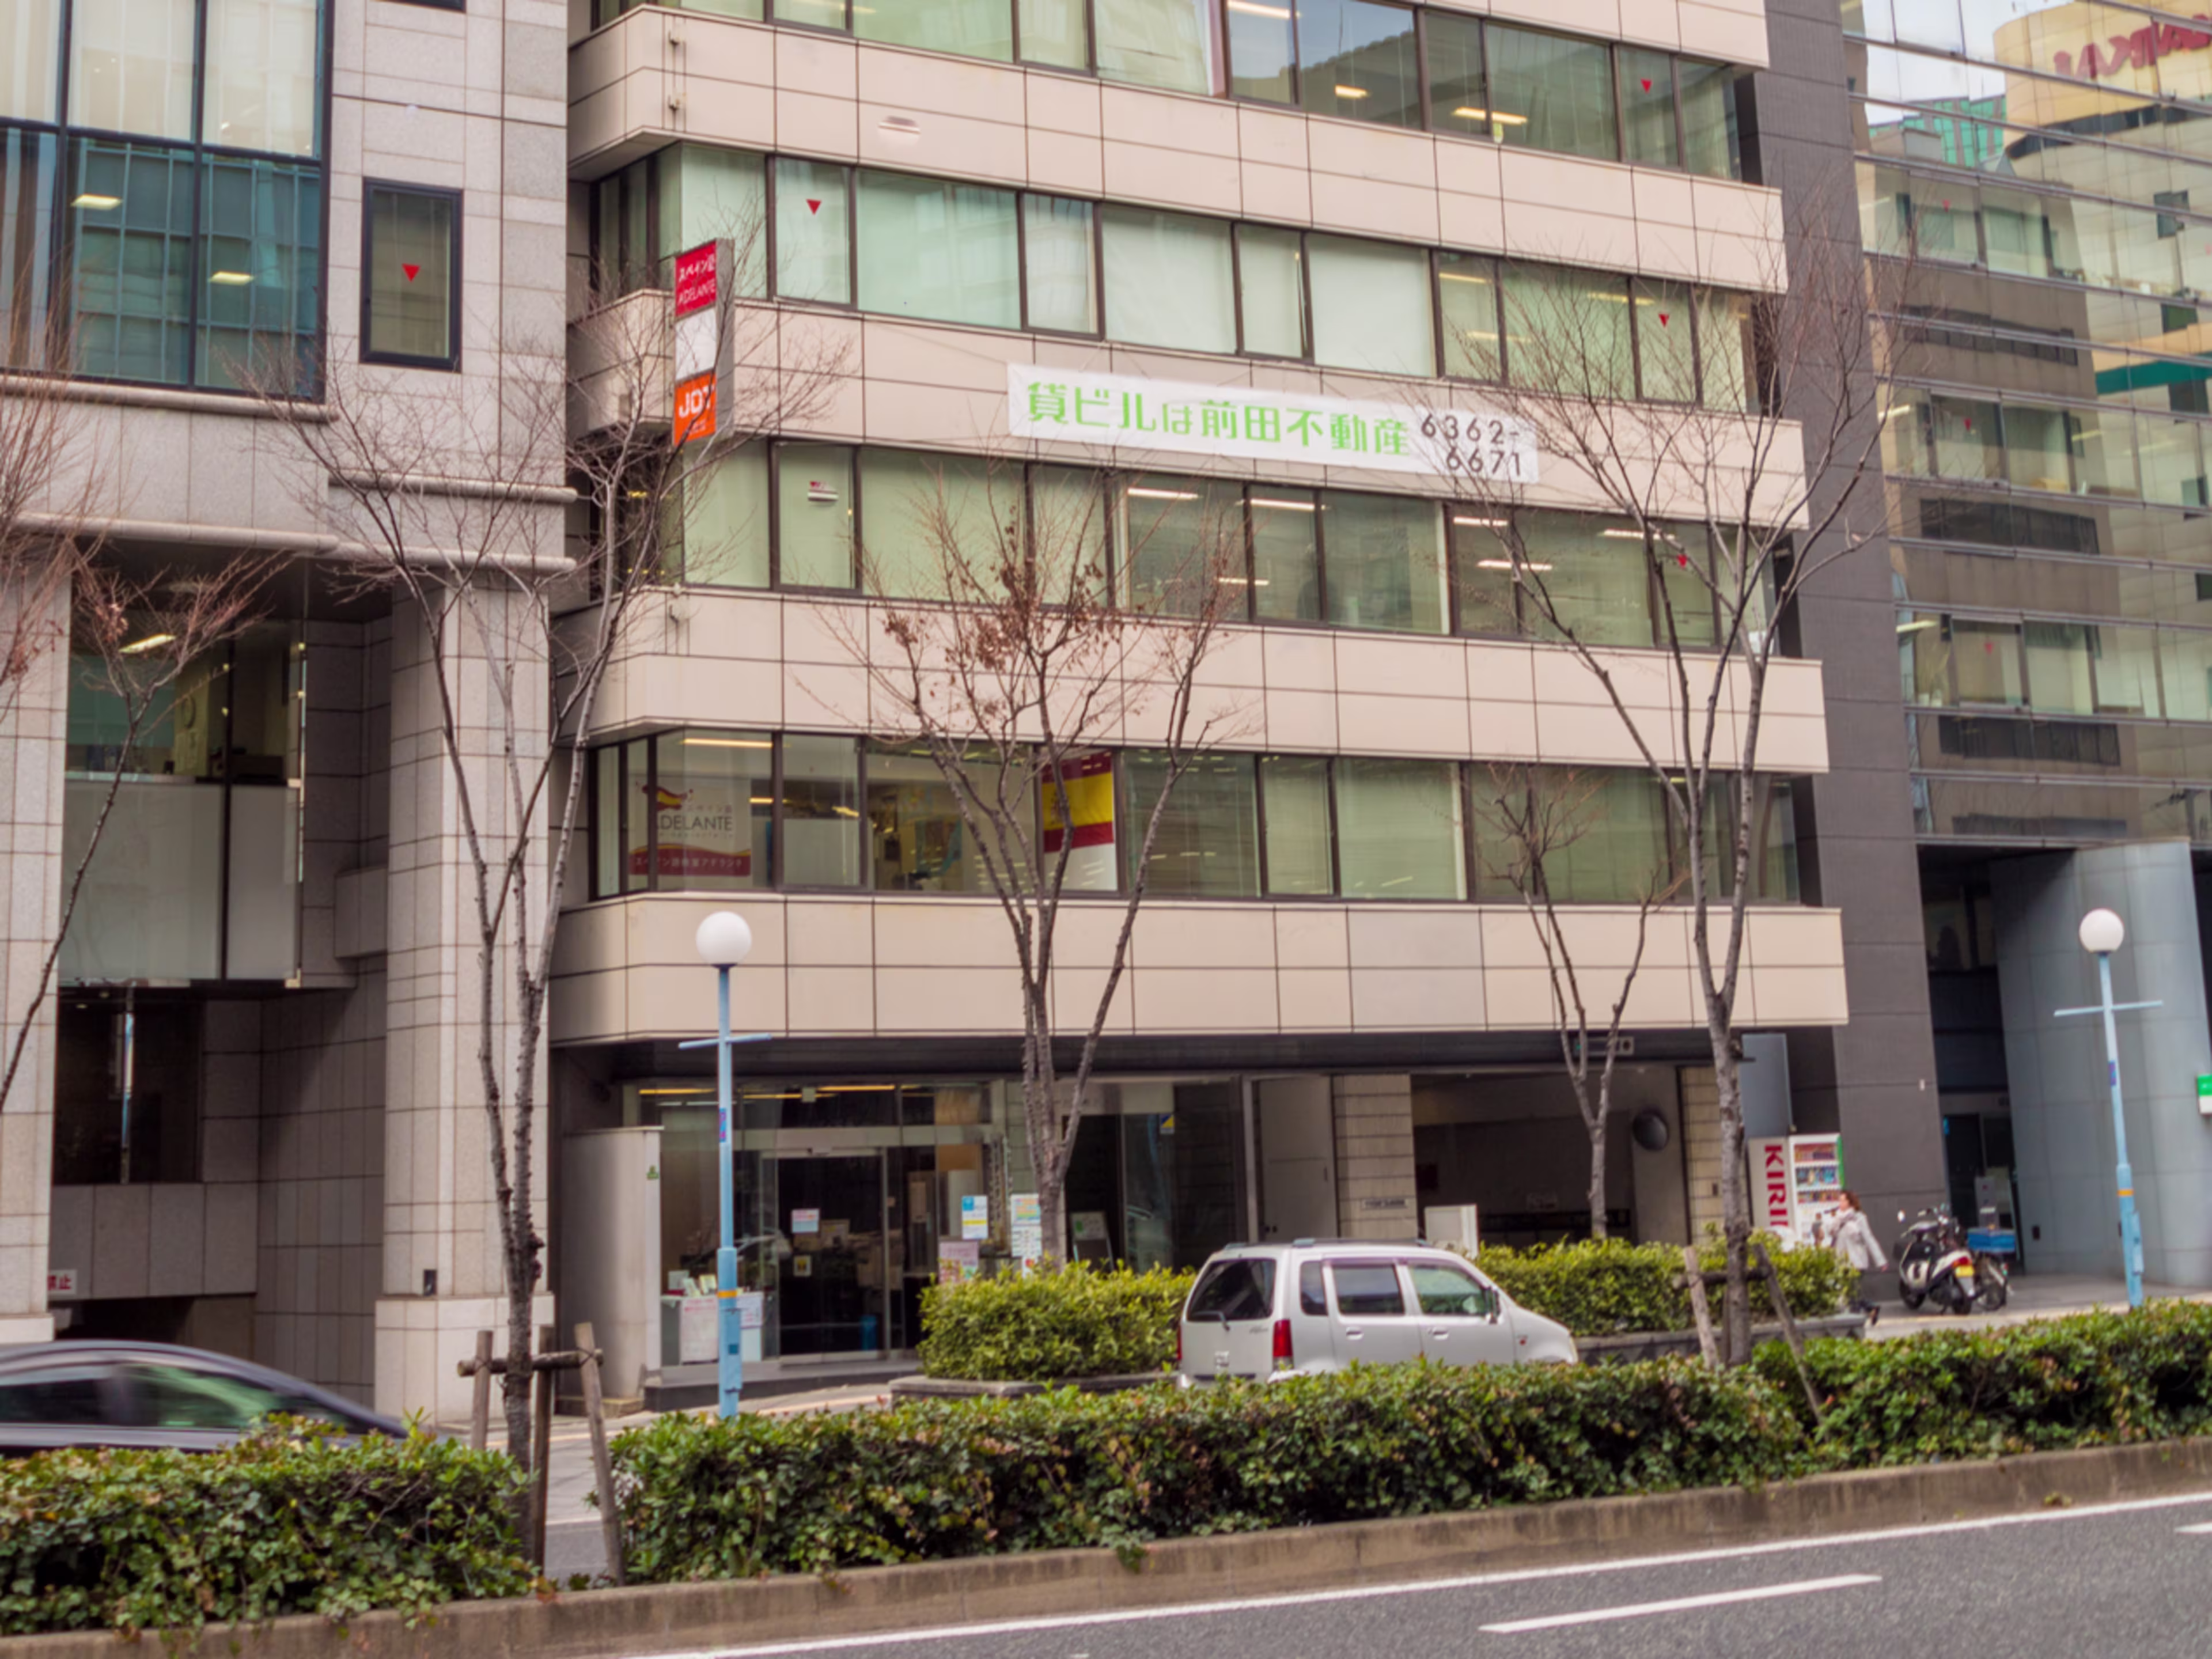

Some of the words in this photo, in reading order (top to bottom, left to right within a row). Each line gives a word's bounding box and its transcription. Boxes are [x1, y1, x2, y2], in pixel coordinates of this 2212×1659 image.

[1028, 381, 1410, 456] 貸ビルは前田不動産
[1421, 413, 1520, 444] 6362-
[1446, 446, 1521, 476] 6671
[657, 815, 733, 831] DELANTE
